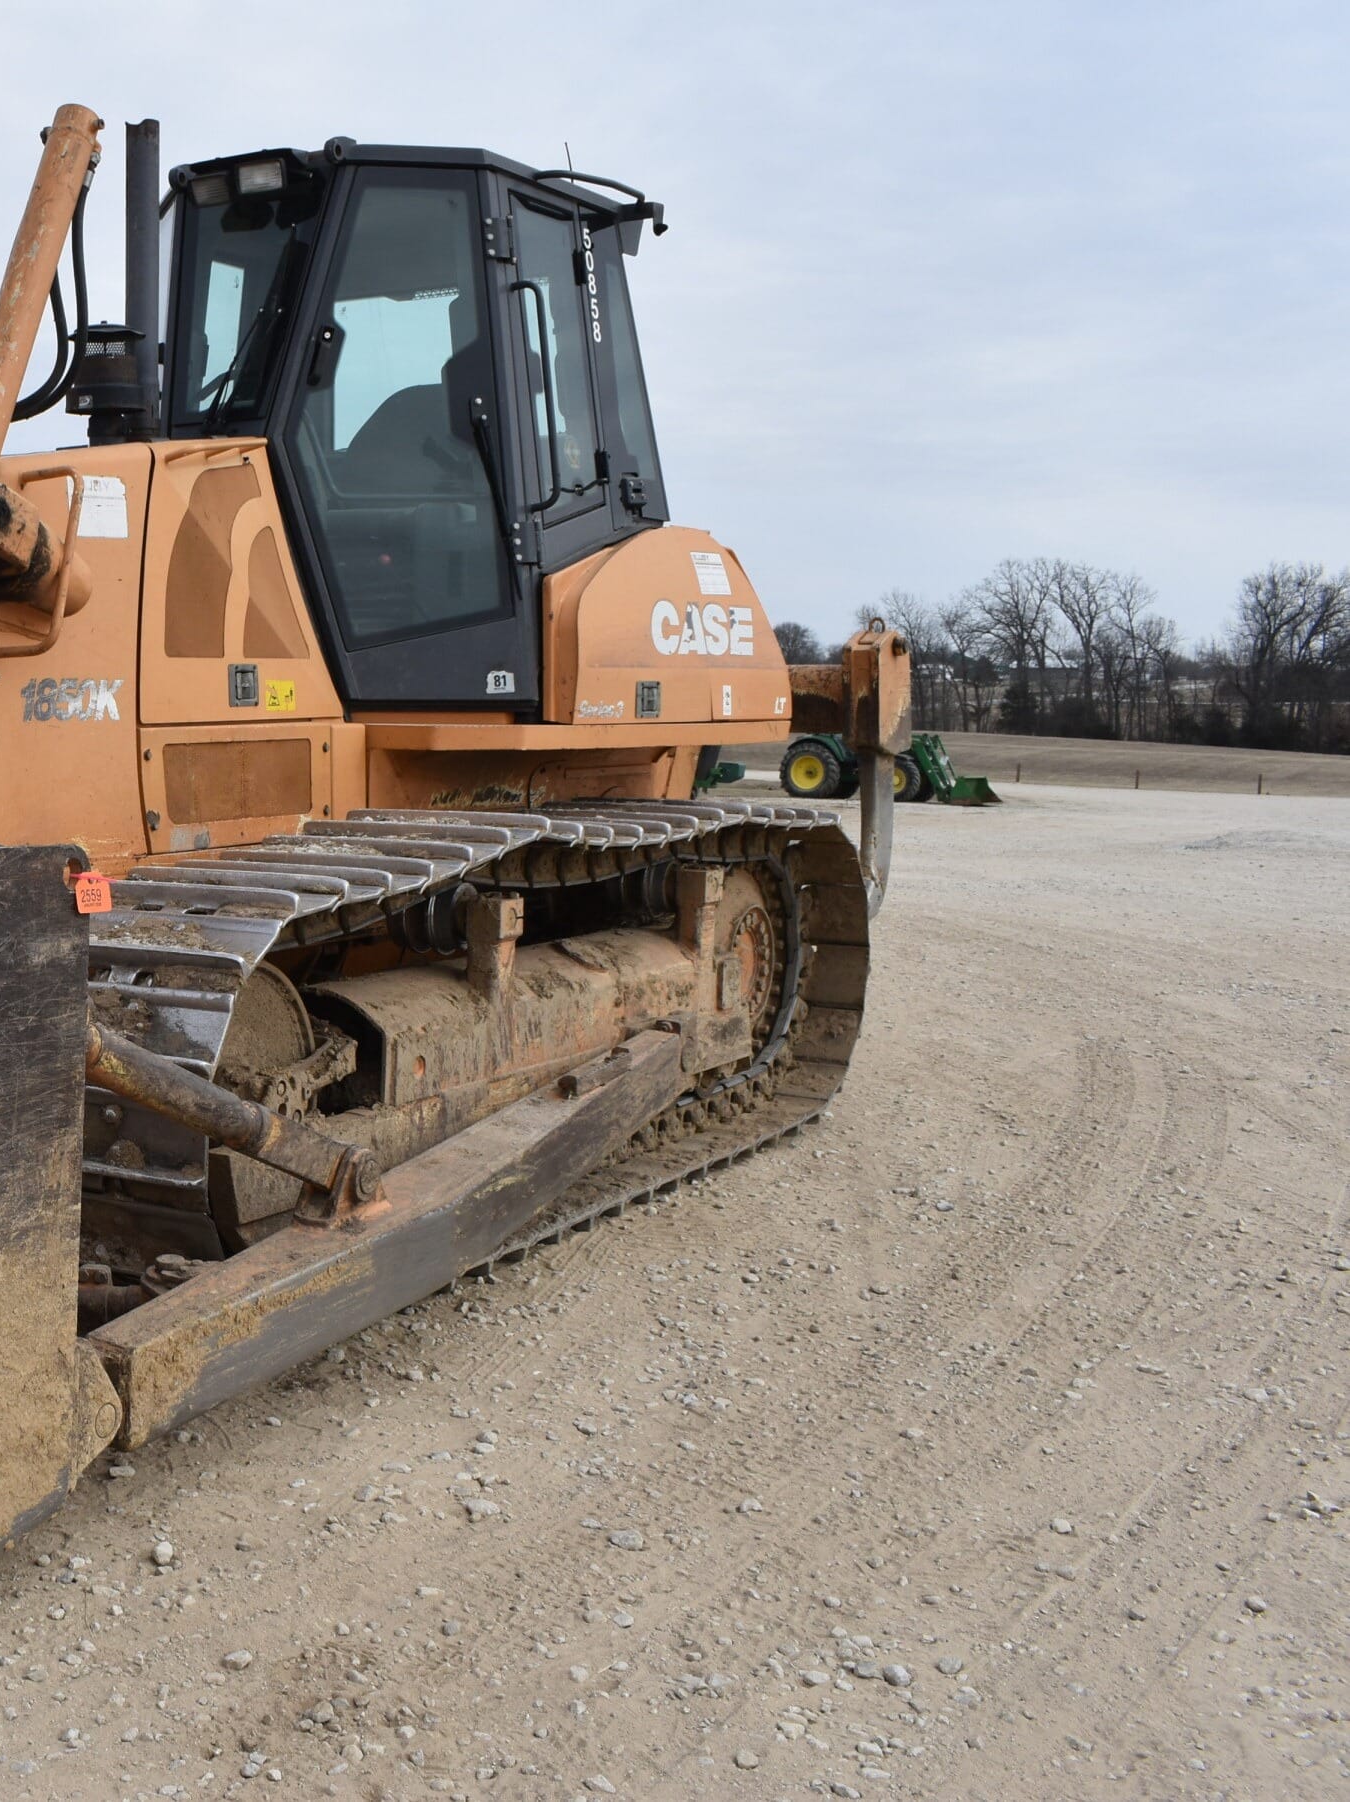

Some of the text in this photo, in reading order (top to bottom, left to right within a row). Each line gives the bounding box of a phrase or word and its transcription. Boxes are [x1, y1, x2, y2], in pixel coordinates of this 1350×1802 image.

[582, 227, 602, 343] 50858
[651, 600, 754, 656] CASE
[21, 678, 124, 722] 1850K
[493, 674, 507, 687] 81
[80, 888, 102, 903] 2559
